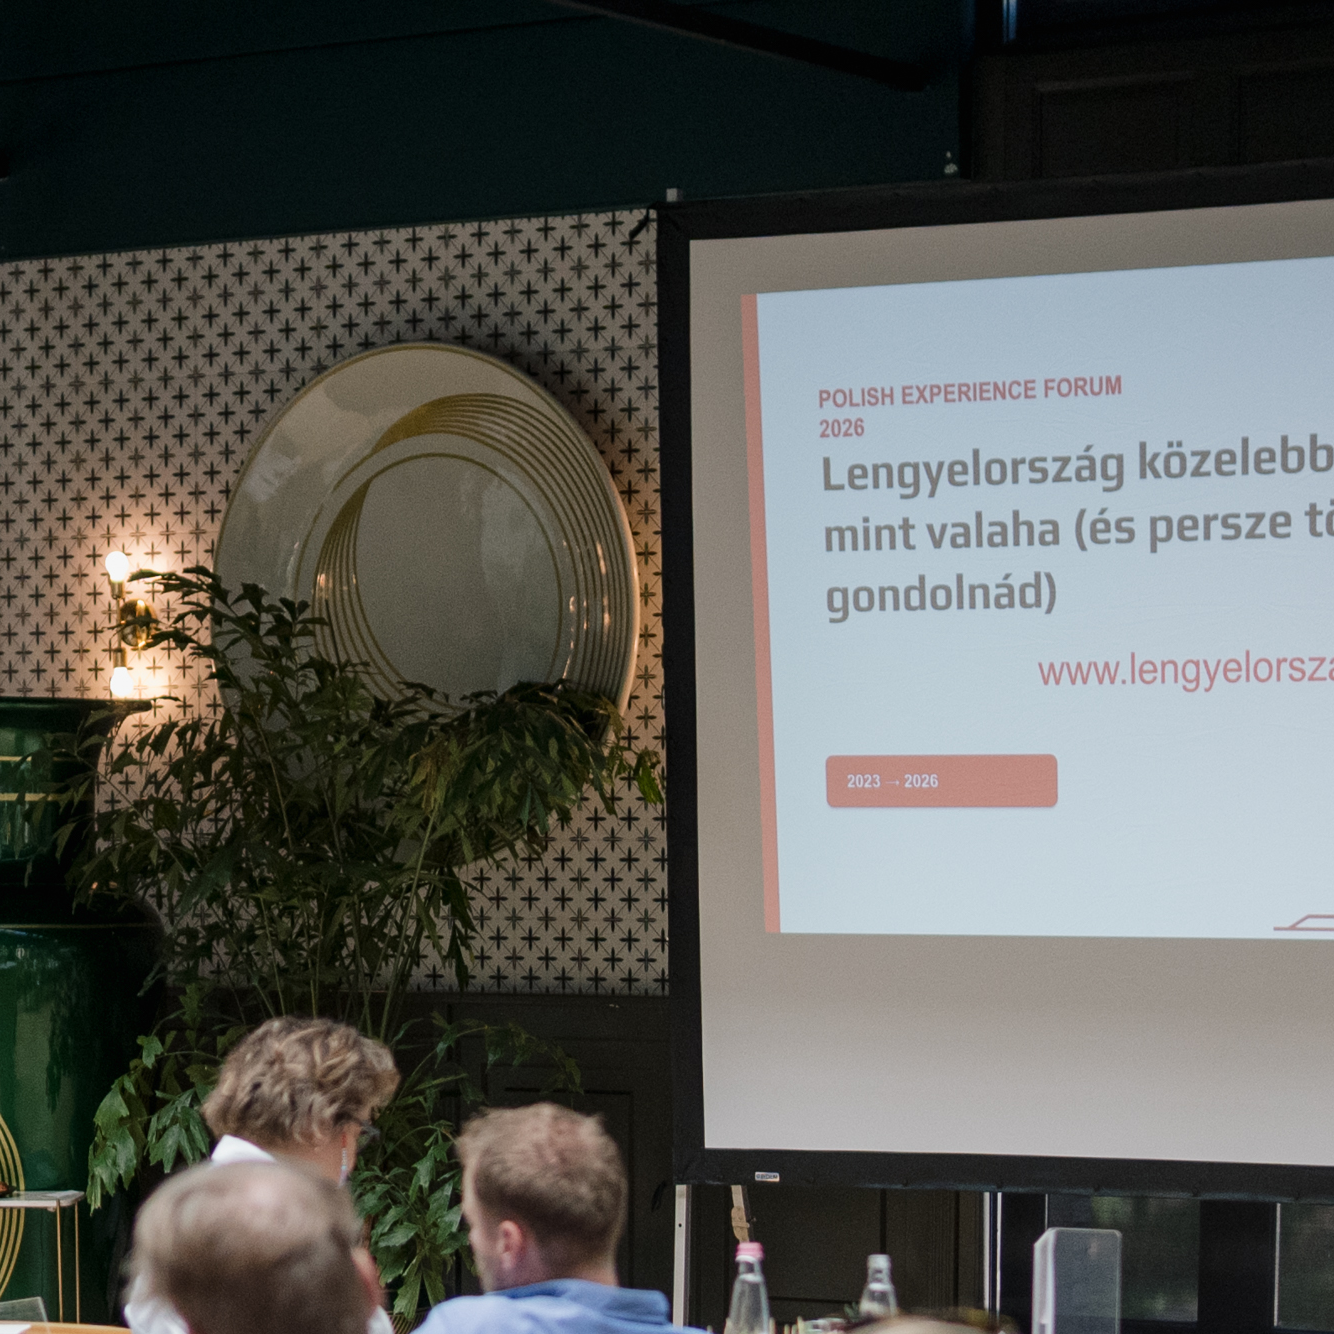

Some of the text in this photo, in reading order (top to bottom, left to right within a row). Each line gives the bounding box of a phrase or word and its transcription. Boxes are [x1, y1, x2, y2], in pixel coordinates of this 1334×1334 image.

[818, 374, 1123, 409] POLISH EXPERIENCE FORUM
[819, 417, 866, 439] 2026
[821, 444, 1125, 500] Lengyelország
[824, 516, 916, 553] mint
[926, 509, 1060, 550] valaha
[1073, 507, 1136, 552] (és
[1149, 510, 1292, 554] persze
[826, 570, 1057, 624] gondolnád)
[846, 773, 939, 789] 2023 2026
